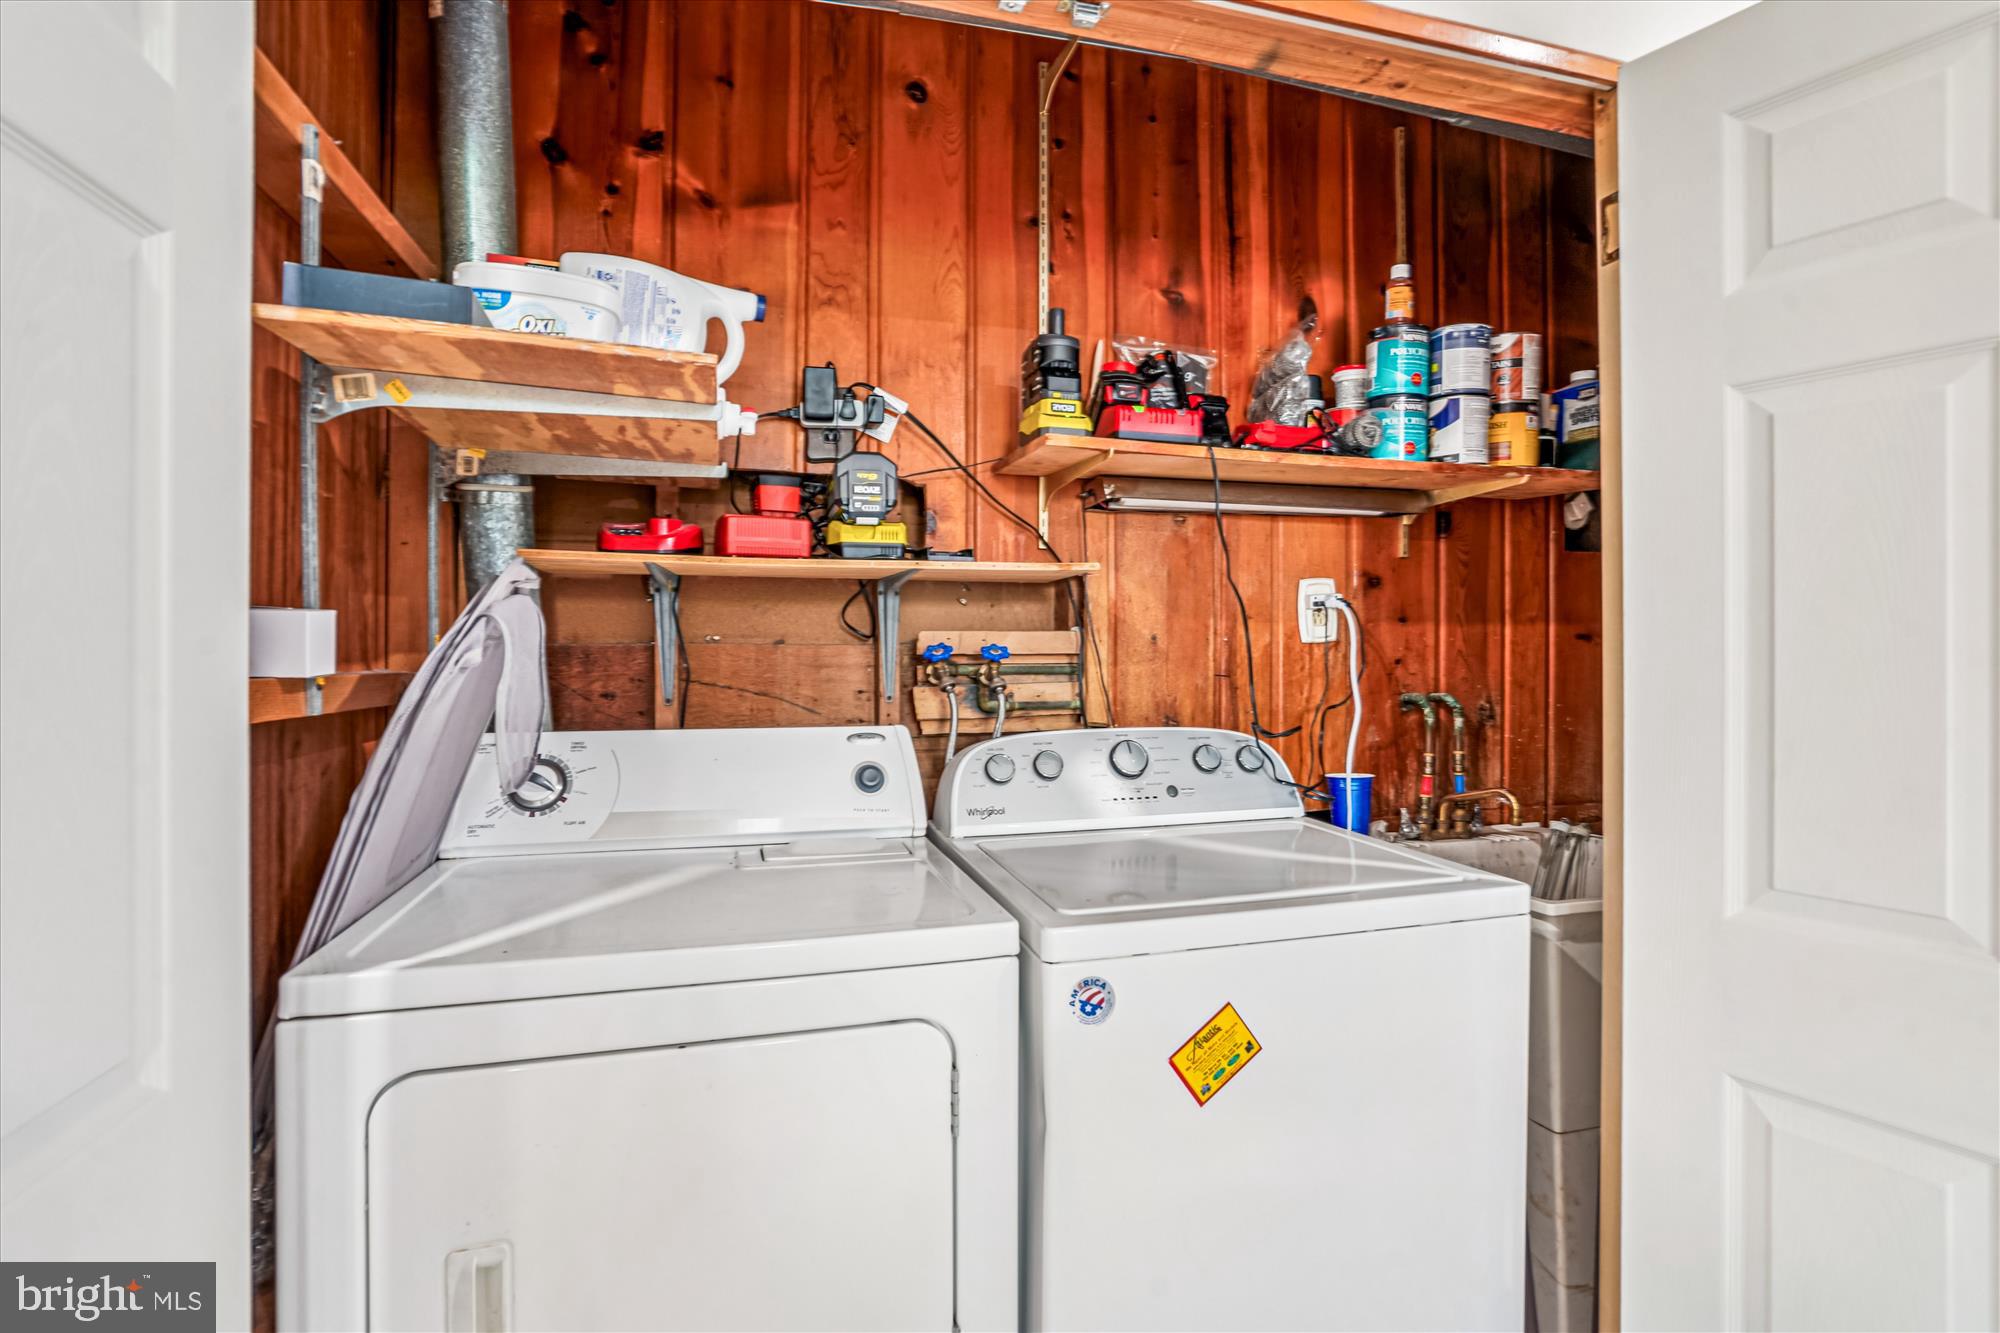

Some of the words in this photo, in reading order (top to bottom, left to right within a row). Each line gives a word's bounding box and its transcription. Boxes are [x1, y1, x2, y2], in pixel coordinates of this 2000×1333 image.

[519, 314, 555, 333] OXI
[966, 806, 1006, 820] Whirlpool
[1069, 978, 1106, 1007] AMERICA
